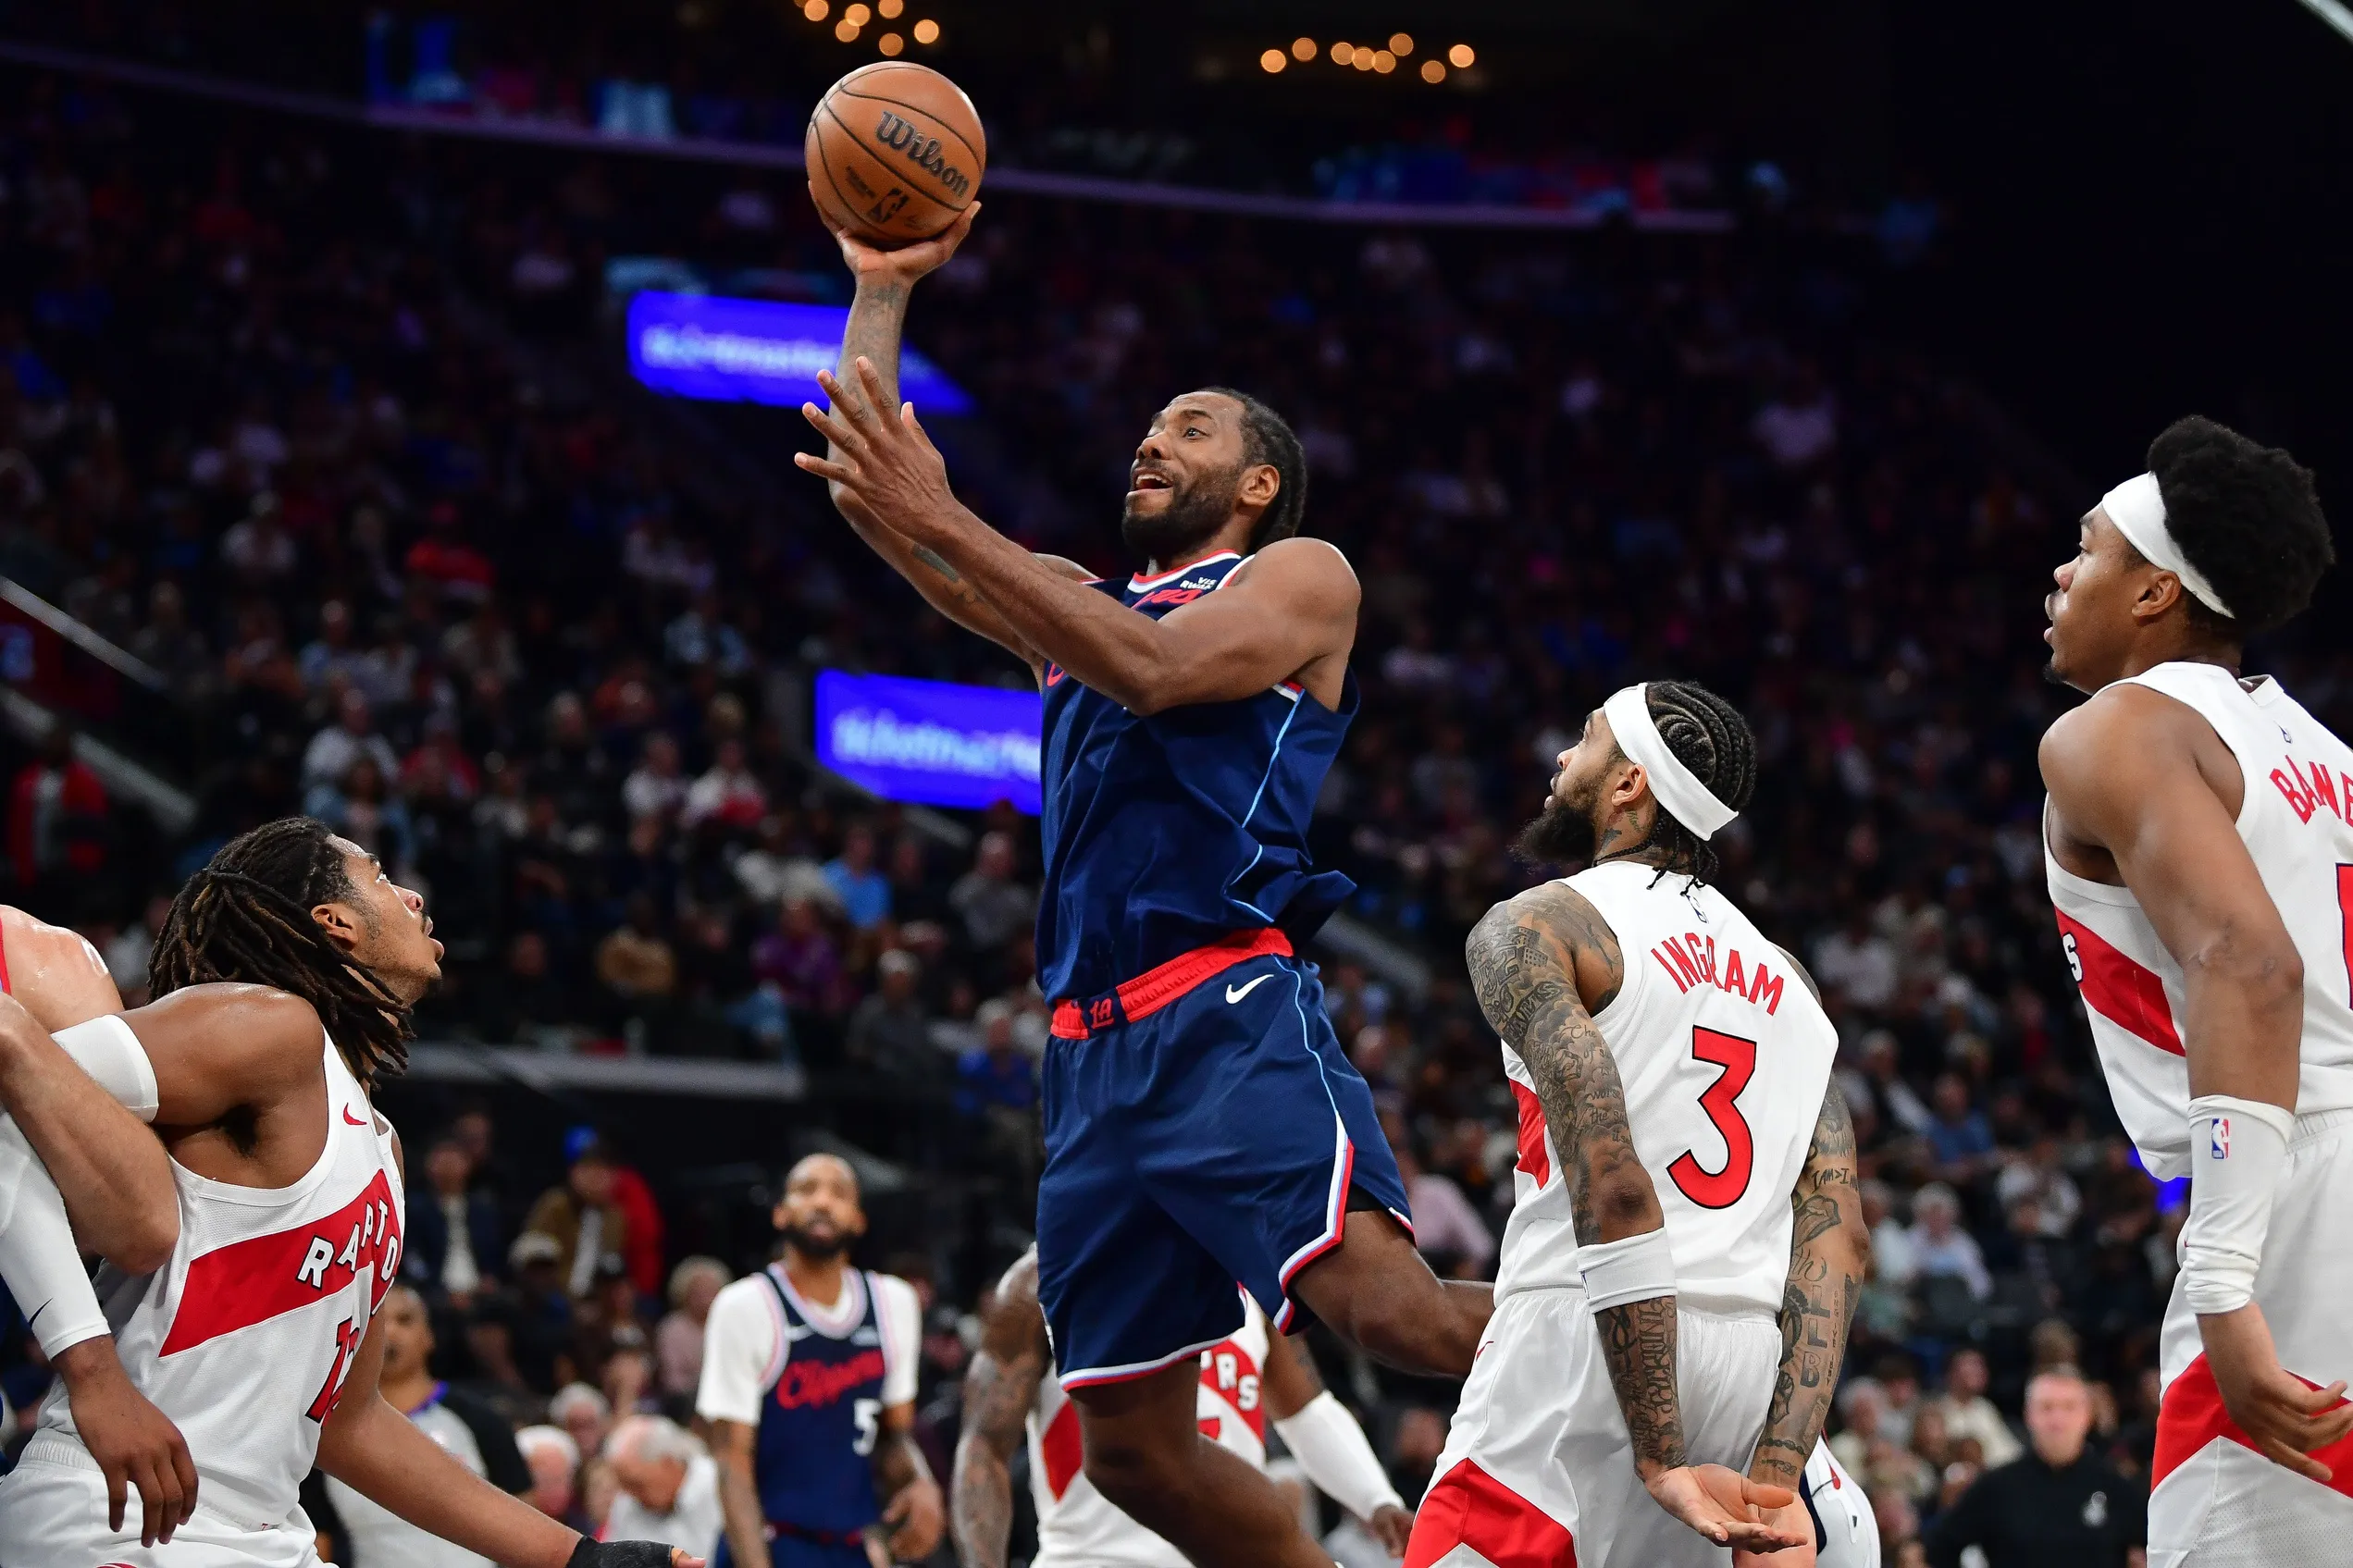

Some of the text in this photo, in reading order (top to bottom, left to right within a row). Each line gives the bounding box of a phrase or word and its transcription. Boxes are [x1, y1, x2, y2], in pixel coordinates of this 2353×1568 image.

[875, 110, 970, 198] Wilson
[1090, 998, 1114, 1029] LA
[1651, 932, 1784, 1016] INGRAM
[1666, 1025, 1757, 1210] 3
[297, 1198, 399, 1315] RAPTO
[852, 1397, 883, 1457] 5
